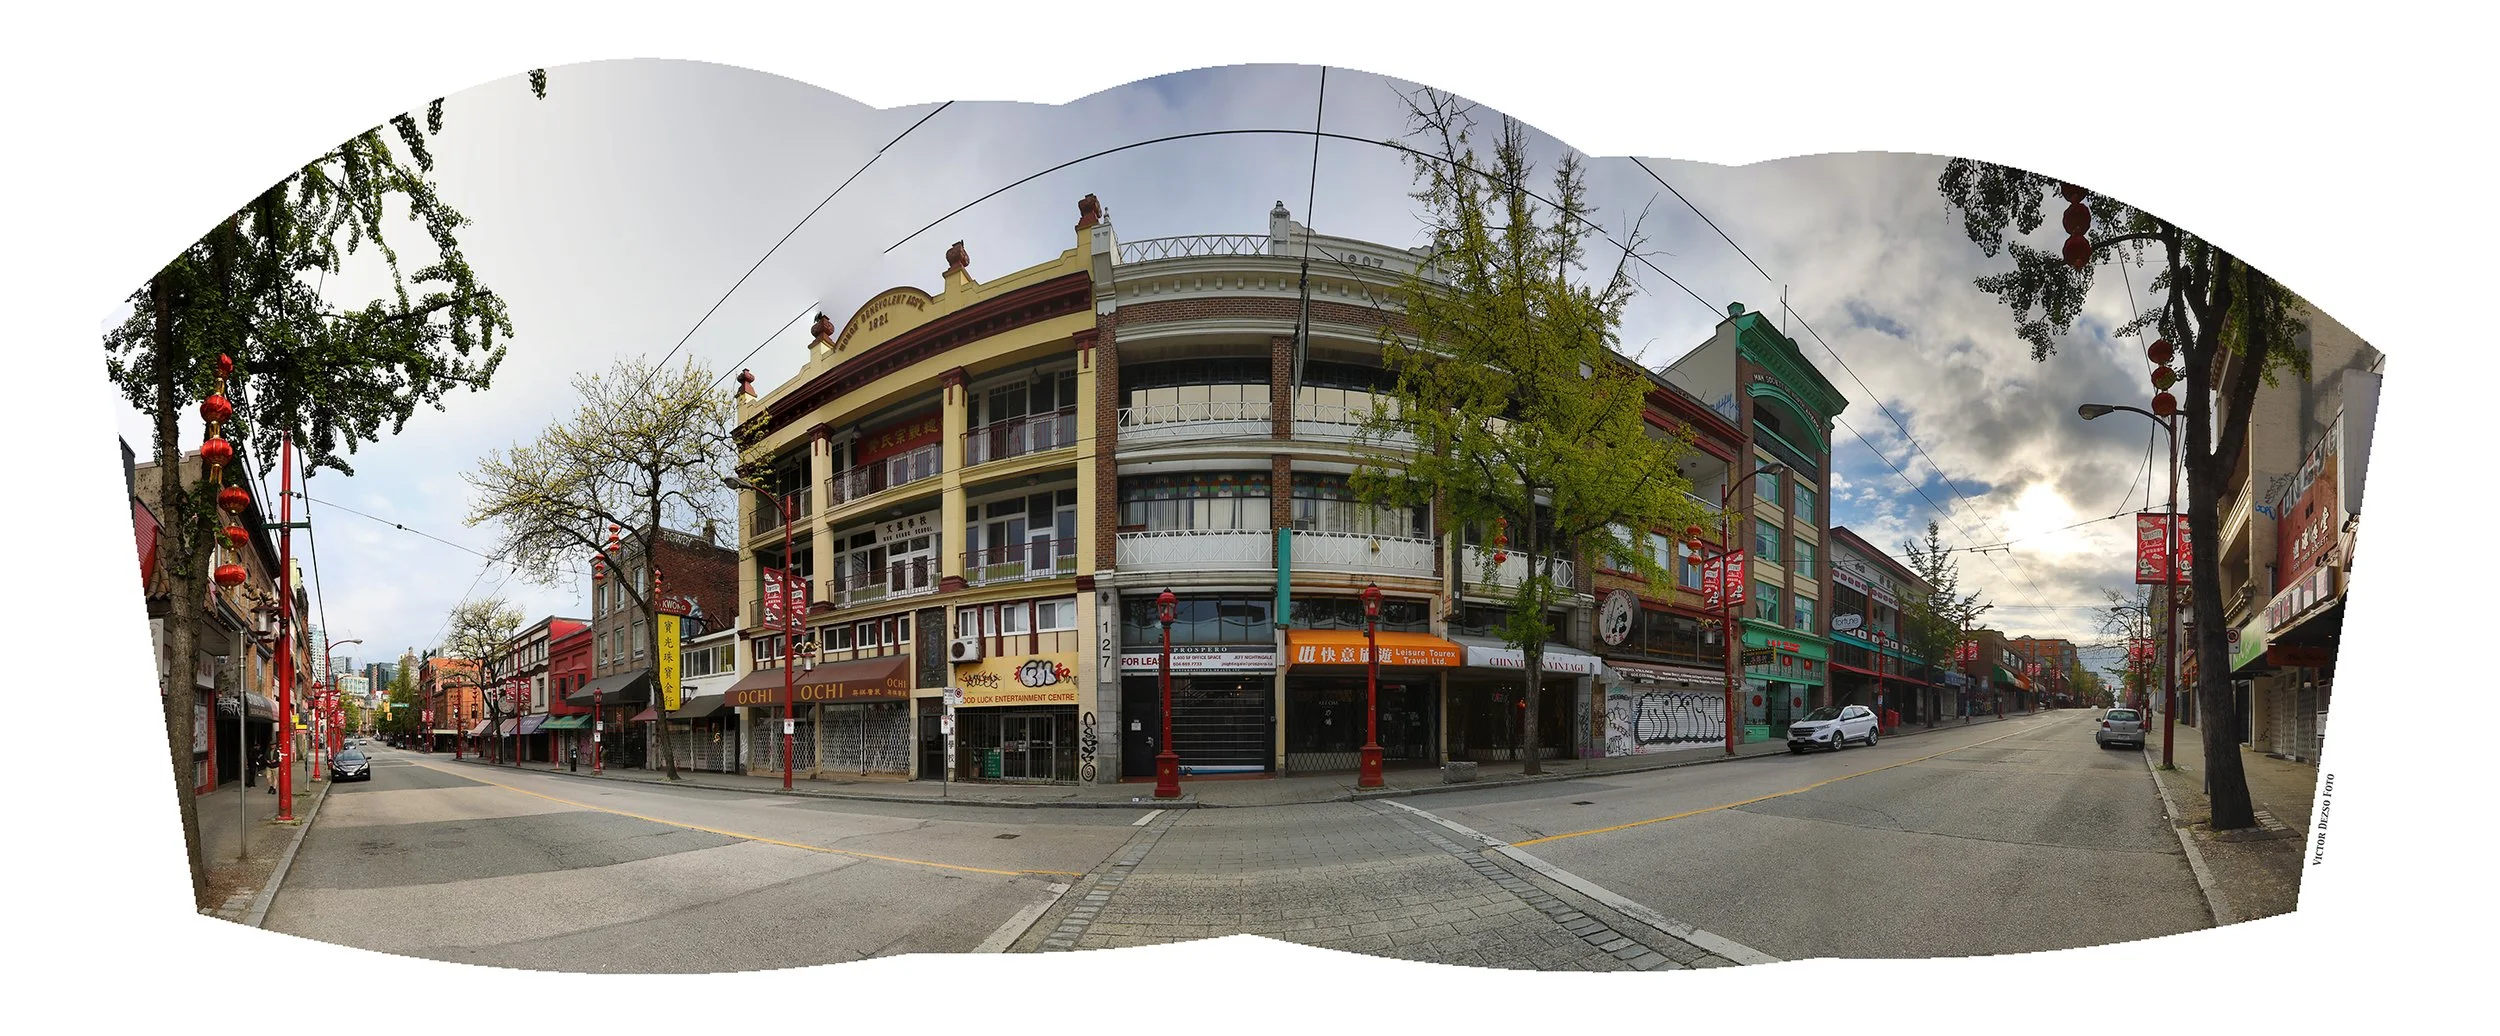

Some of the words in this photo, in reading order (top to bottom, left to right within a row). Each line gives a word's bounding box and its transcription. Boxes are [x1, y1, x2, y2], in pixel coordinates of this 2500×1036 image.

[1340, 252, 1384, 268] 1907
[861, 294, 907, 323] BENEVOLENT
[869, 312, 889, 332] 1921
[915, 526, 932, 534] SCHOOL
[1835, 617, 1859, 627] fortune
[1102, 621, 1111, 668] 127
[1395, 648, 1426, 657] Leisure
[1429, 649, 1455, 658] Tourex
[1121, 657, 1139, 666] FOR
[1403, 657, 1428, 665] Travel
[1432, 657, 1447, 665] Ltd.
[1548, 662, 1585, 672] VINTAGE
[887, 677, 907, 689] OCHI
[738, 689, 772, 705] OCHI
[801, 683, 844, 701] OCHI
[995, 694, 1047, 703] ENTERTAINMENT
[1048, 693, 1074, 701] CENTRE
